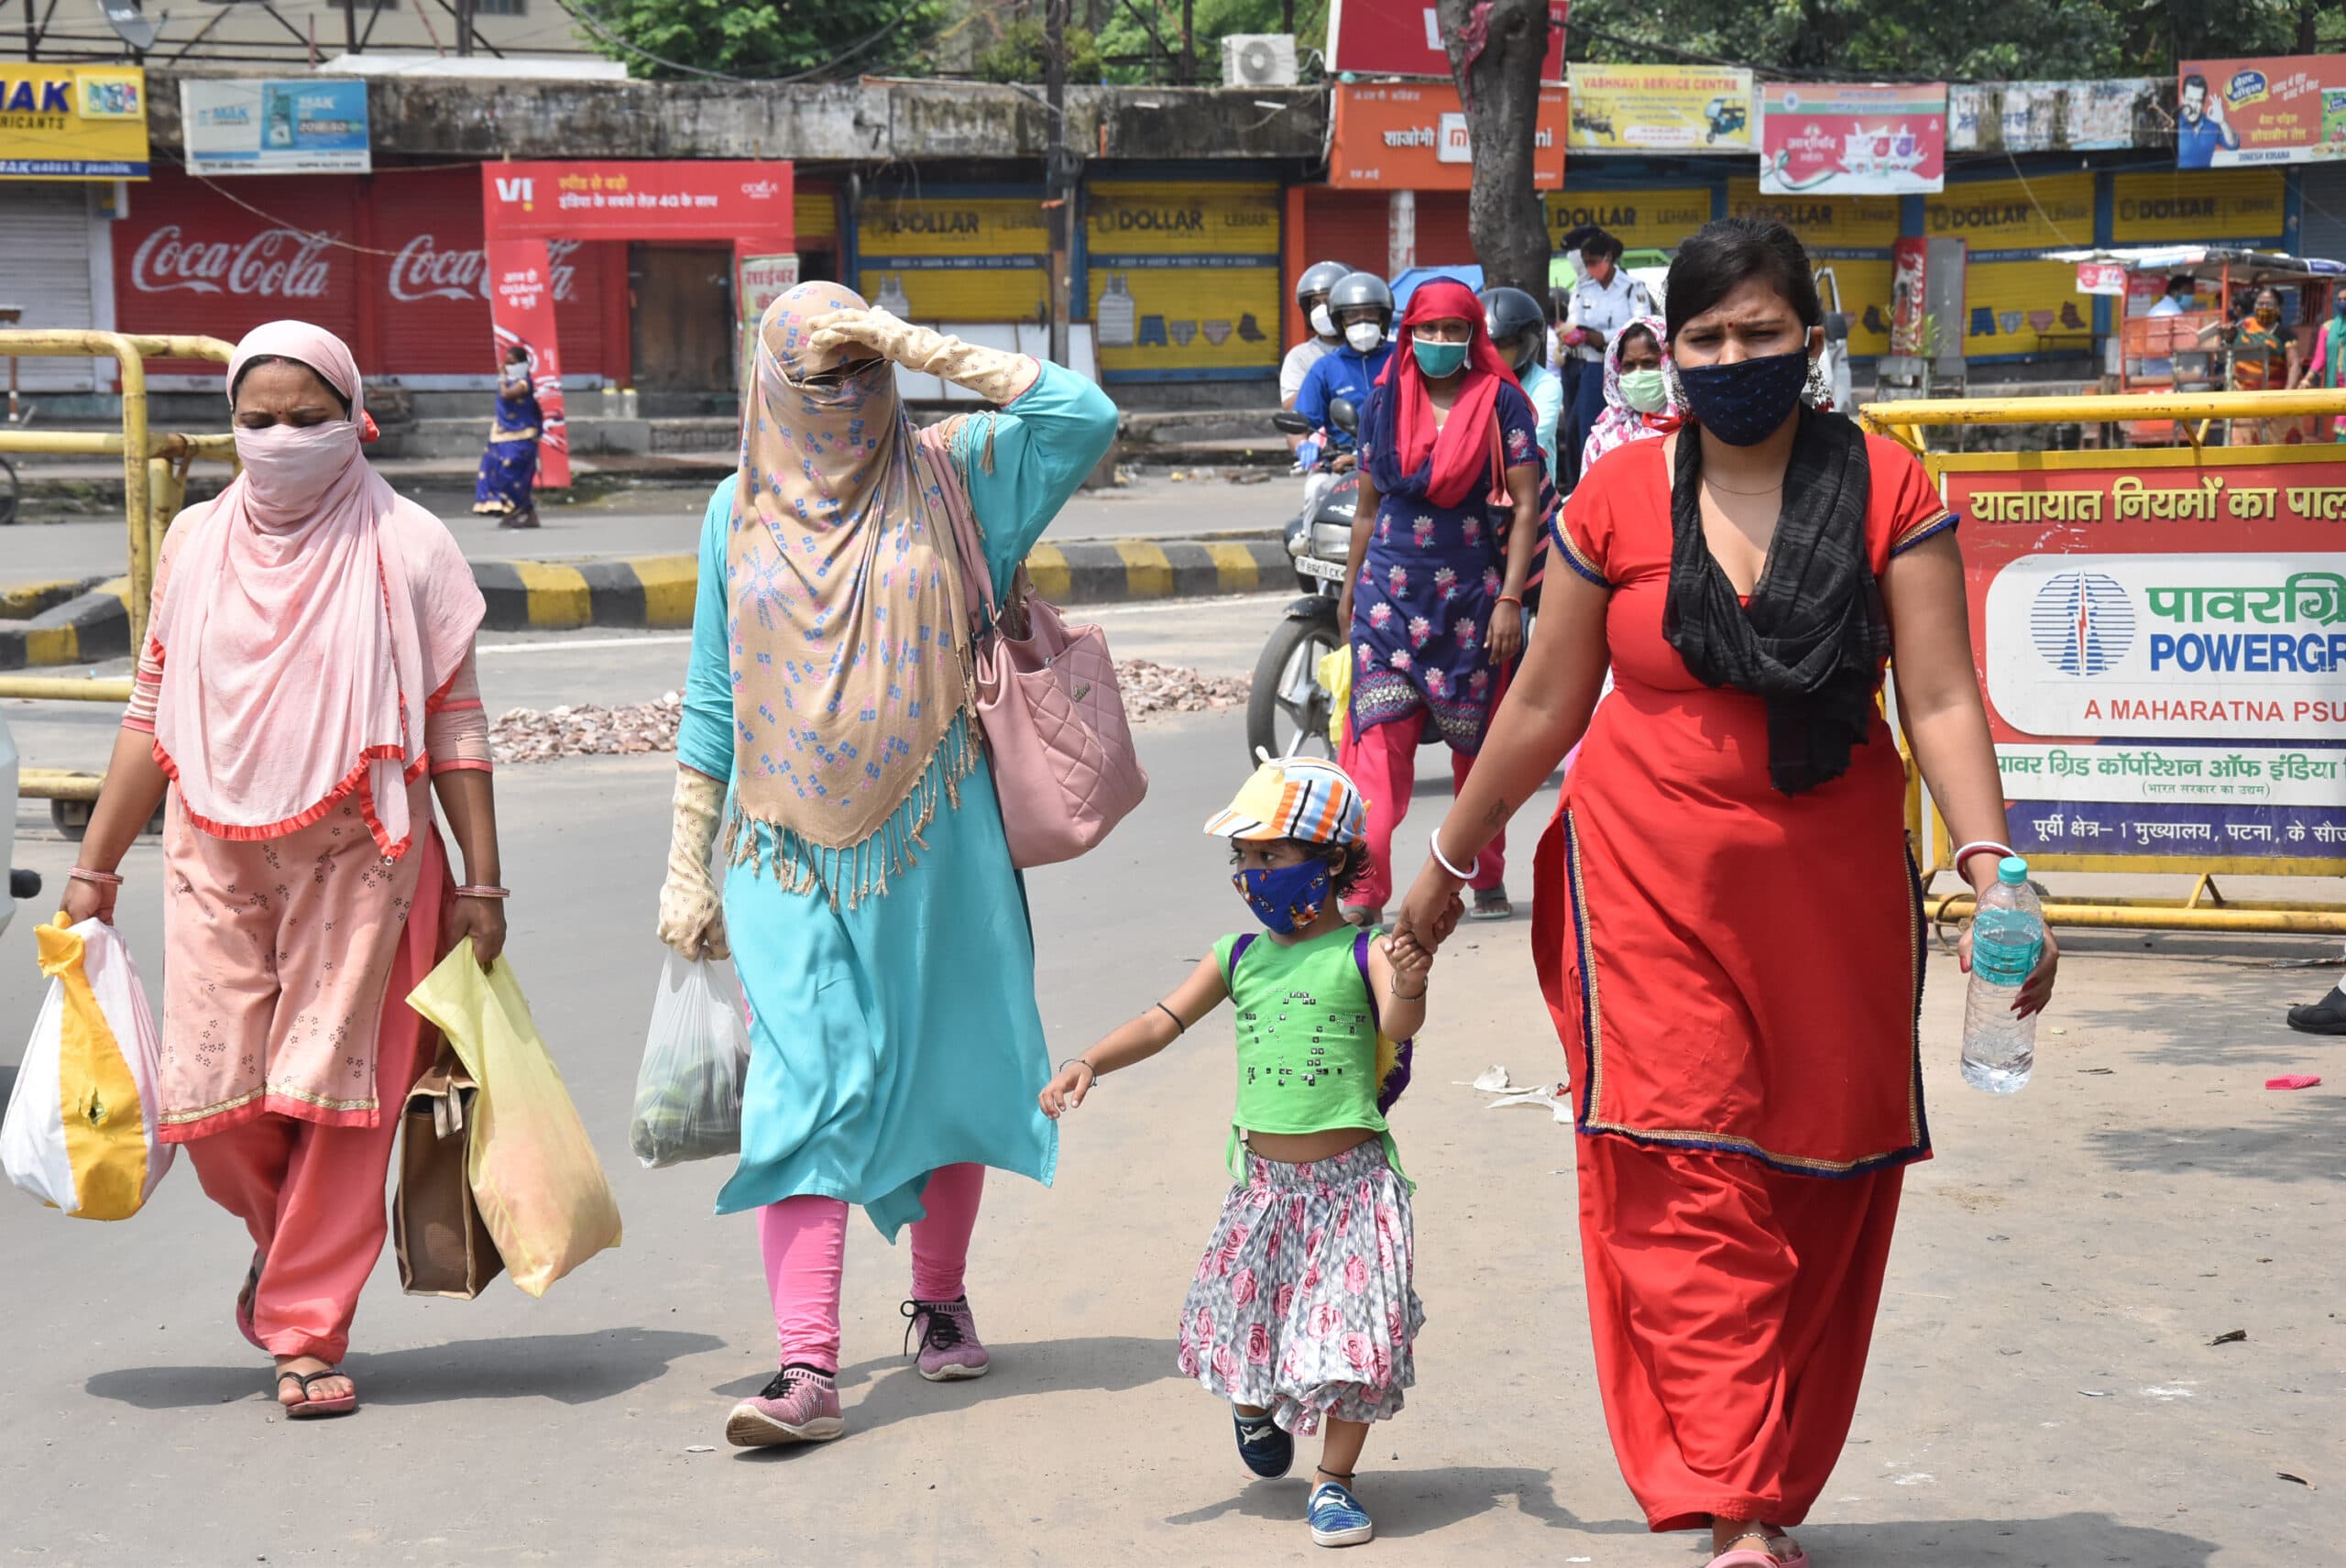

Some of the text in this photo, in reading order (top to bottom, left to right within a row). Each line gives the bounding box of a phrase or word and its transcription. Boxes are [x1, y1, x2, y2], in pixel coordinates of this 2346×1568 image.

[1119, 208, 1204, 231] DOLLAR
[1558, 207, 1637, 228] DOLLAR
[1952, 203, 2029, 228] DOLLAR
[2139, 198, 2215, 220] DOLLAR
[1969, 490, 2104, 521] यातायात
[2110, 476, 2224, 521] नियमों
[2228, 488, 2278, 519] का
[2150, 632, 2346, 674] POWERGR
[2083, 699, 2346, 722] A MAHARATNA PSU
[2047, 749, 2091, 778] ग्रिड
[2096, 751, 2203, 777] कॉर्पोरेशन
[2209, 753, 2263, 778] ऑफ
[2267, 752, 2338, 781] इंडिया
[2180, 784, 2217, 795] सरकार
[2220, 784, 2234, 795] का
[2032, 814, 2065, 842] पूर्वी
[2286, 818, 2307, 842] के
